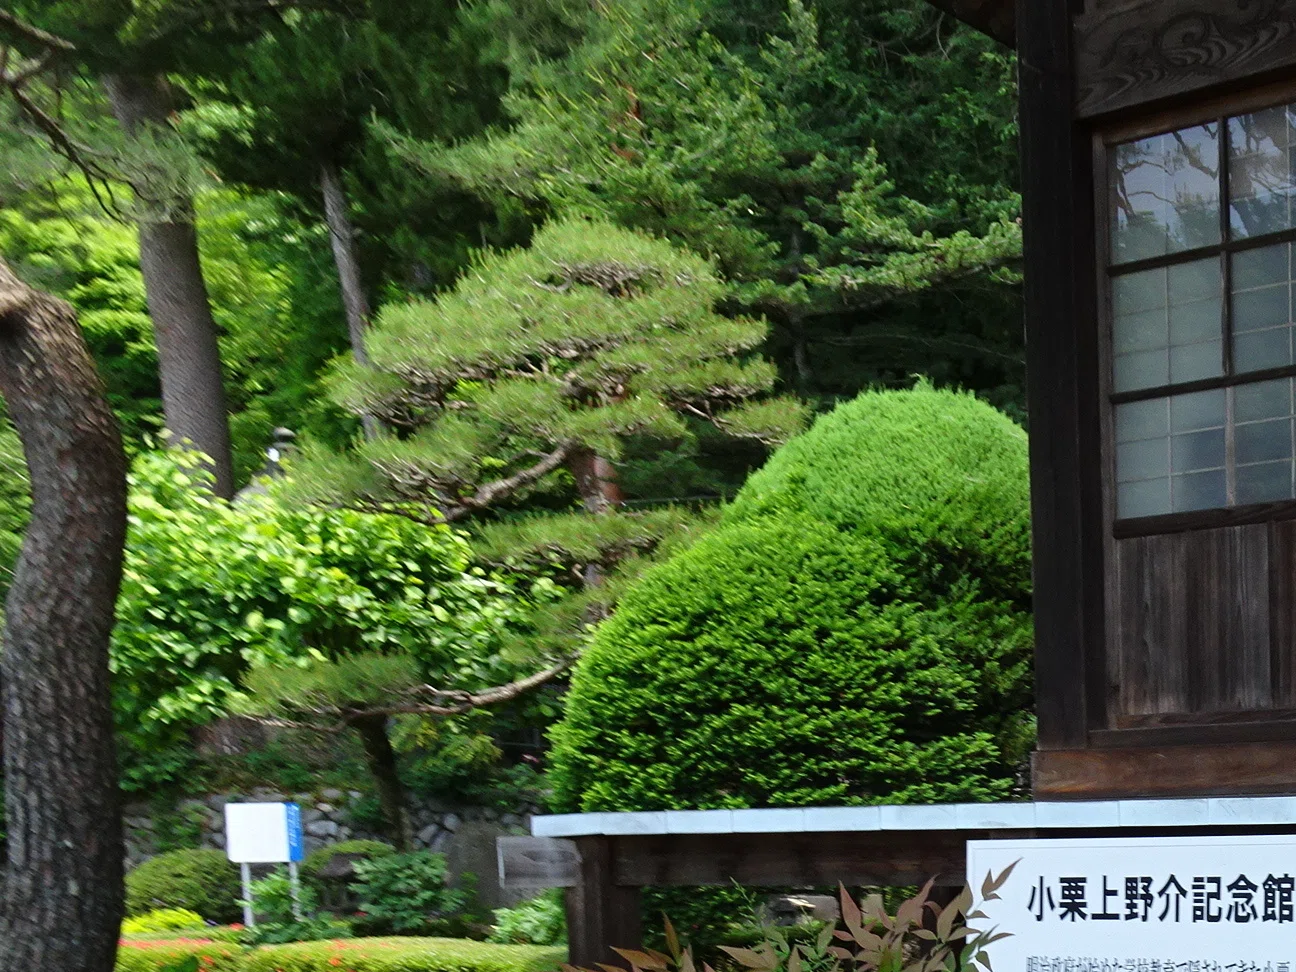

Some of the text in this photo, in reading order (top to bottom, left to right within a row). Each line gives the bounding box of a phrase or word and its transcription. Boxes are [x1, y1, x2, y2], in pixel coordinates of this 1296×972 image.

[1027, 873, 1296, 924] 小栗上野介記念館
